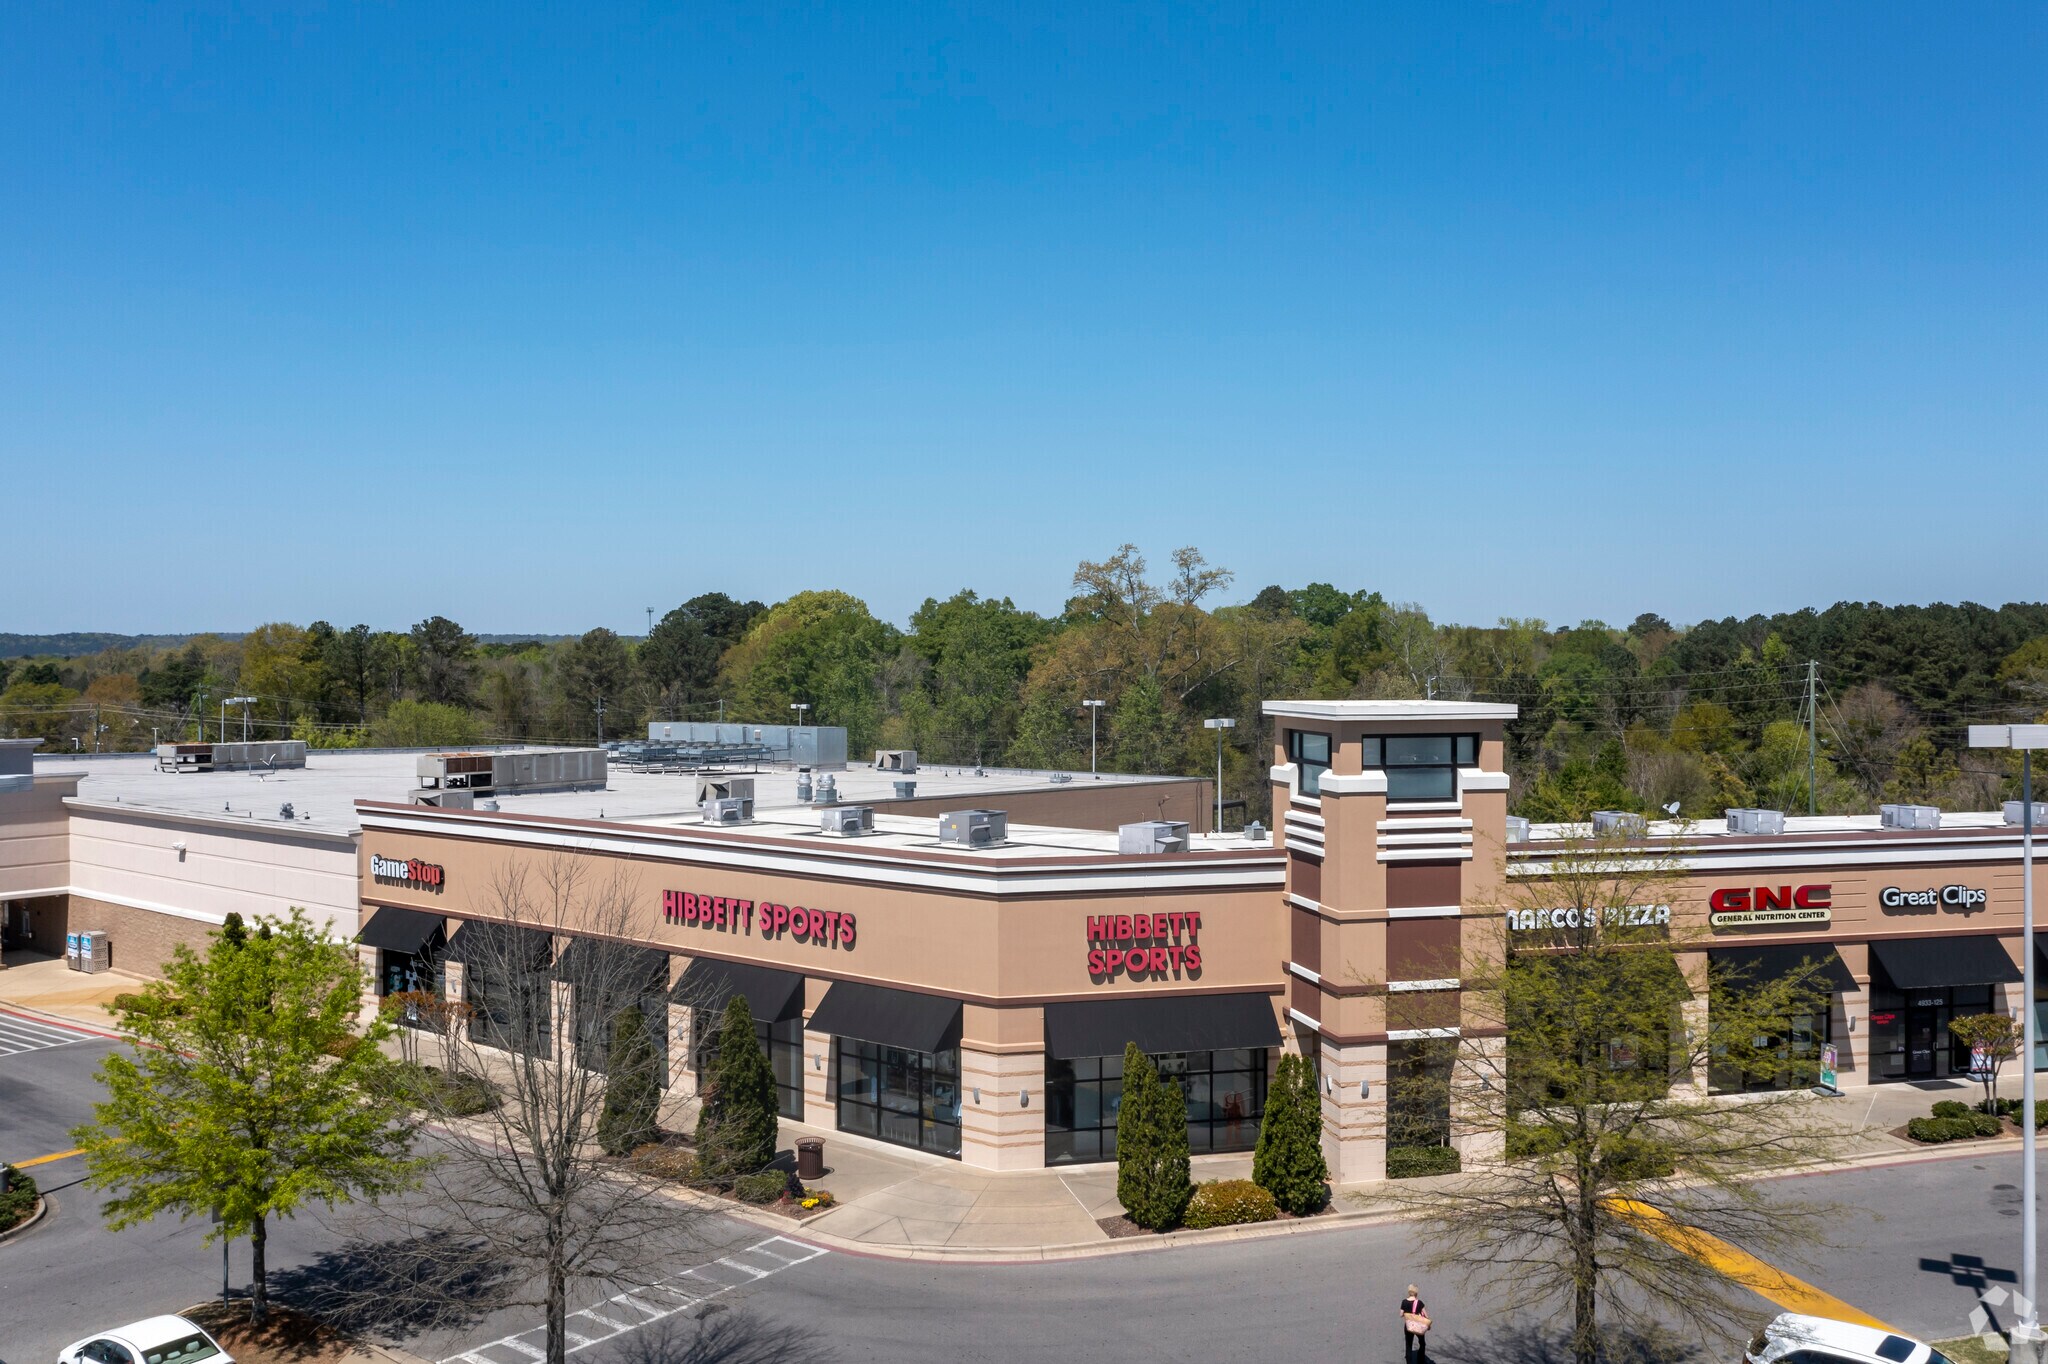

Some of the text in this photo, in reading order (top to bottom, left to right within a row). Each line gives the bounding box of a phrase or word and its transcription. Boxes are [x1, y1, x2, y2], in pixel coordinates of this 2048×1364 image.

[370, 855, 440, 886] GameStop
[1710, 884, 1832, 913] GNC
[1882, 885, 1986, 908] Great Clips
[662, 889, 855, 944] HIBBETT SPORTS
[1086, 911, 1201, 941] HIBBETT
[1717, 911, 1826, 923] GENERAL NUTRITION CENTER
[1087, 944, 1201, 975] SPORTS
